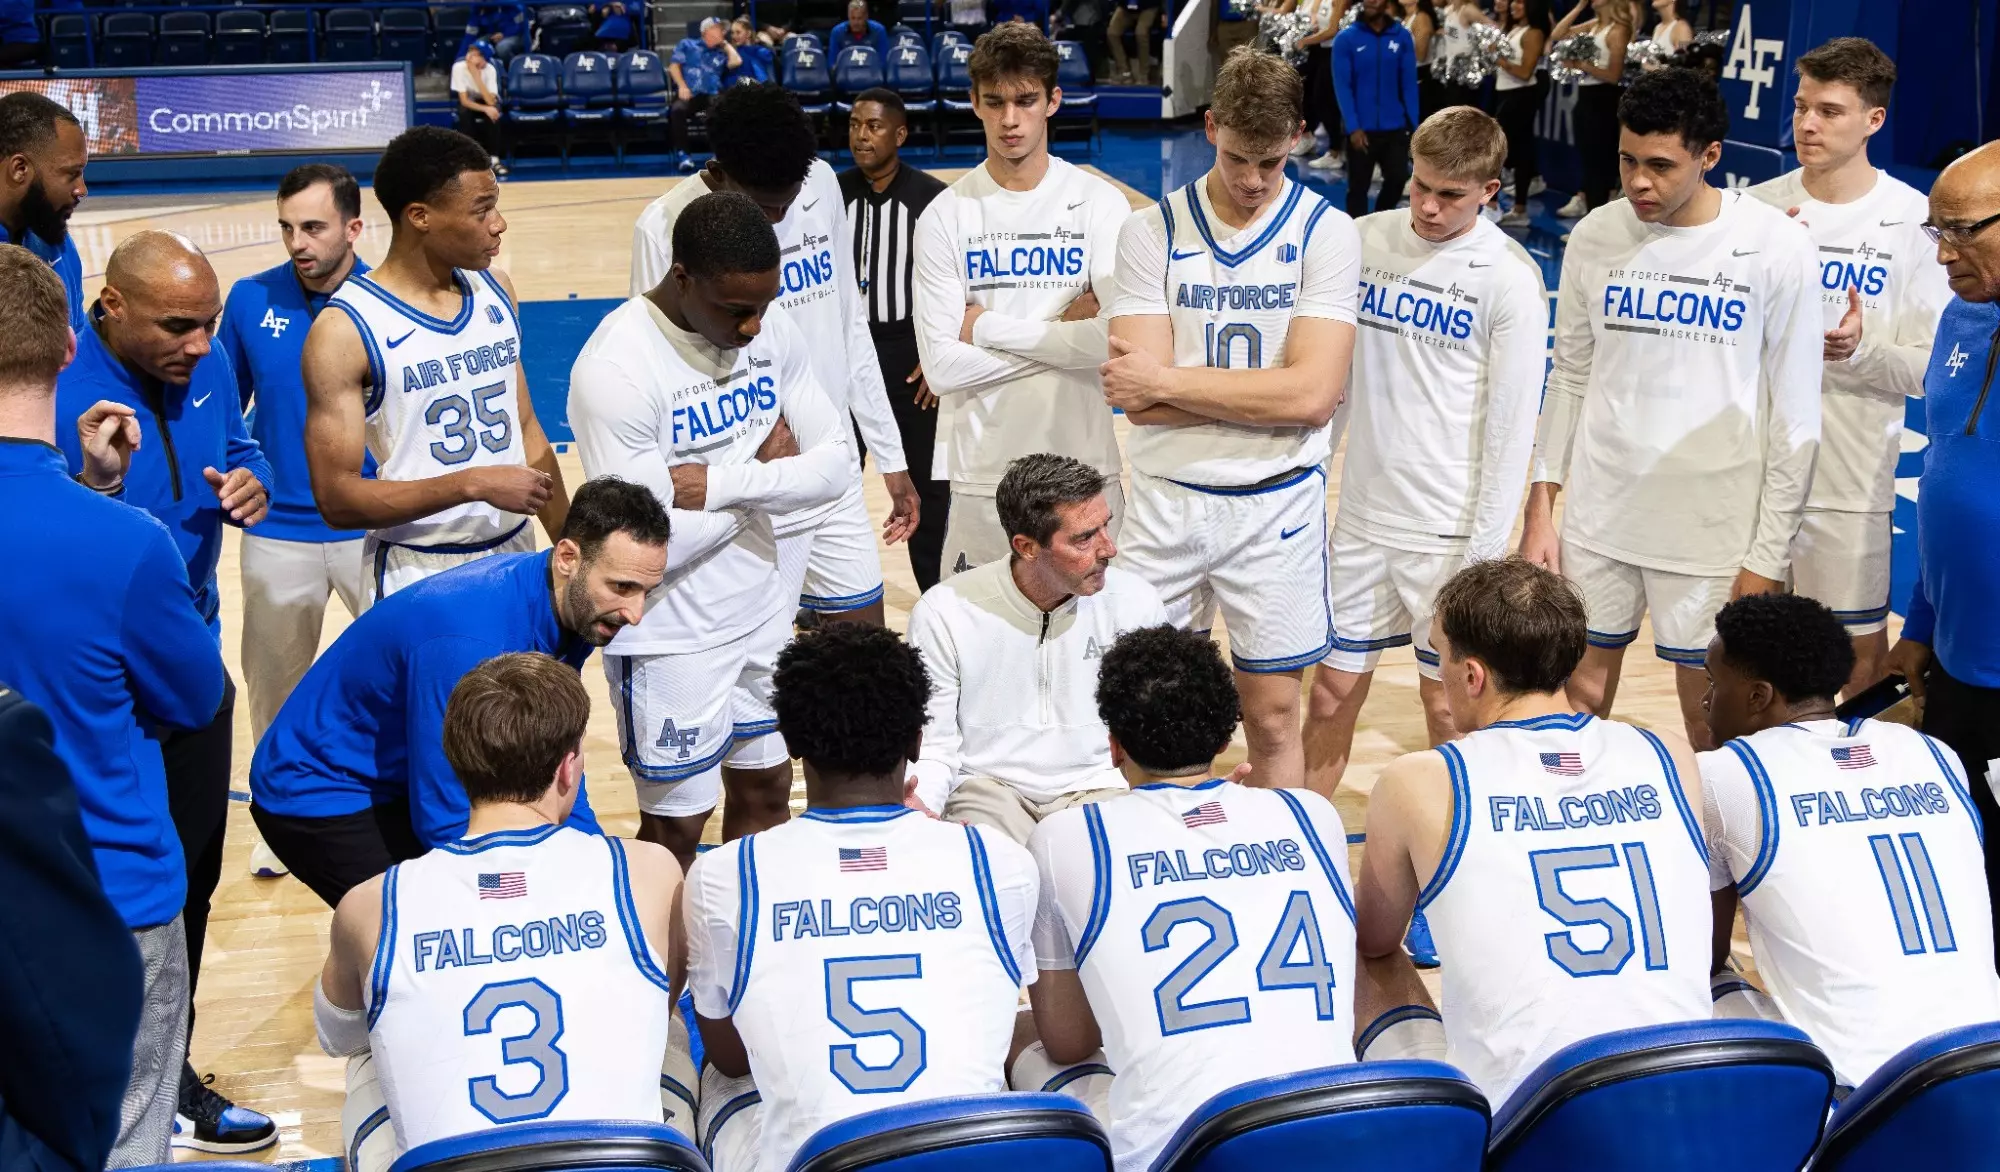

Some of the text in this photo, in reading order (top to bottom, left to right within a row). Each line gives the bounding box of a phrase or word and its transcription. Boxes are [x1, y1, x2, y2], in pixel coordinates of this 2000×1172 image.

[1722, 3, 1784, 120] AF
[149, 103, 371, 136] CommonSpirit
[984, 232, 1016, 241] FORCE
[966, 246, 1084, 279] FALCONS
[1375, 269, 1408, 285] FORCE
[1608, 269, 1667, 282] AIR FORCE
[1176, 282, 1296, 312] AIR FORCE
[1604, 285, 1747, 332] FALCONS
[260, 308, 290, 338] AF
[1399, 328, 1469, 352] BASKETBALL
[1661, 328, 1738, 346] BASKETBALL
[402, 337, 518, 394] AIR FORCE
[1944, 342, 1970, 378] AF
[424, 379, 513, 466] 35
[953, 551, 977, 575] A
[655, 717, 701, 760] AF
[1488, 784, 1663, 833] FALCONS
[1790, 782, 1950, 828] FALCONS
[1127, 838, 1306, 890] FALCONS
[1527, 841, 1669, 979] 51
[1867, 831, 1959, 956] 11
[773, 891, 963, 943] FALCONS
[413, 910, 608, 974] FALCONS
[1140, 890, 1337, 1038] 24
[823, 953, 928, 1095] 5
[462, 976, 570, 1125] 3
